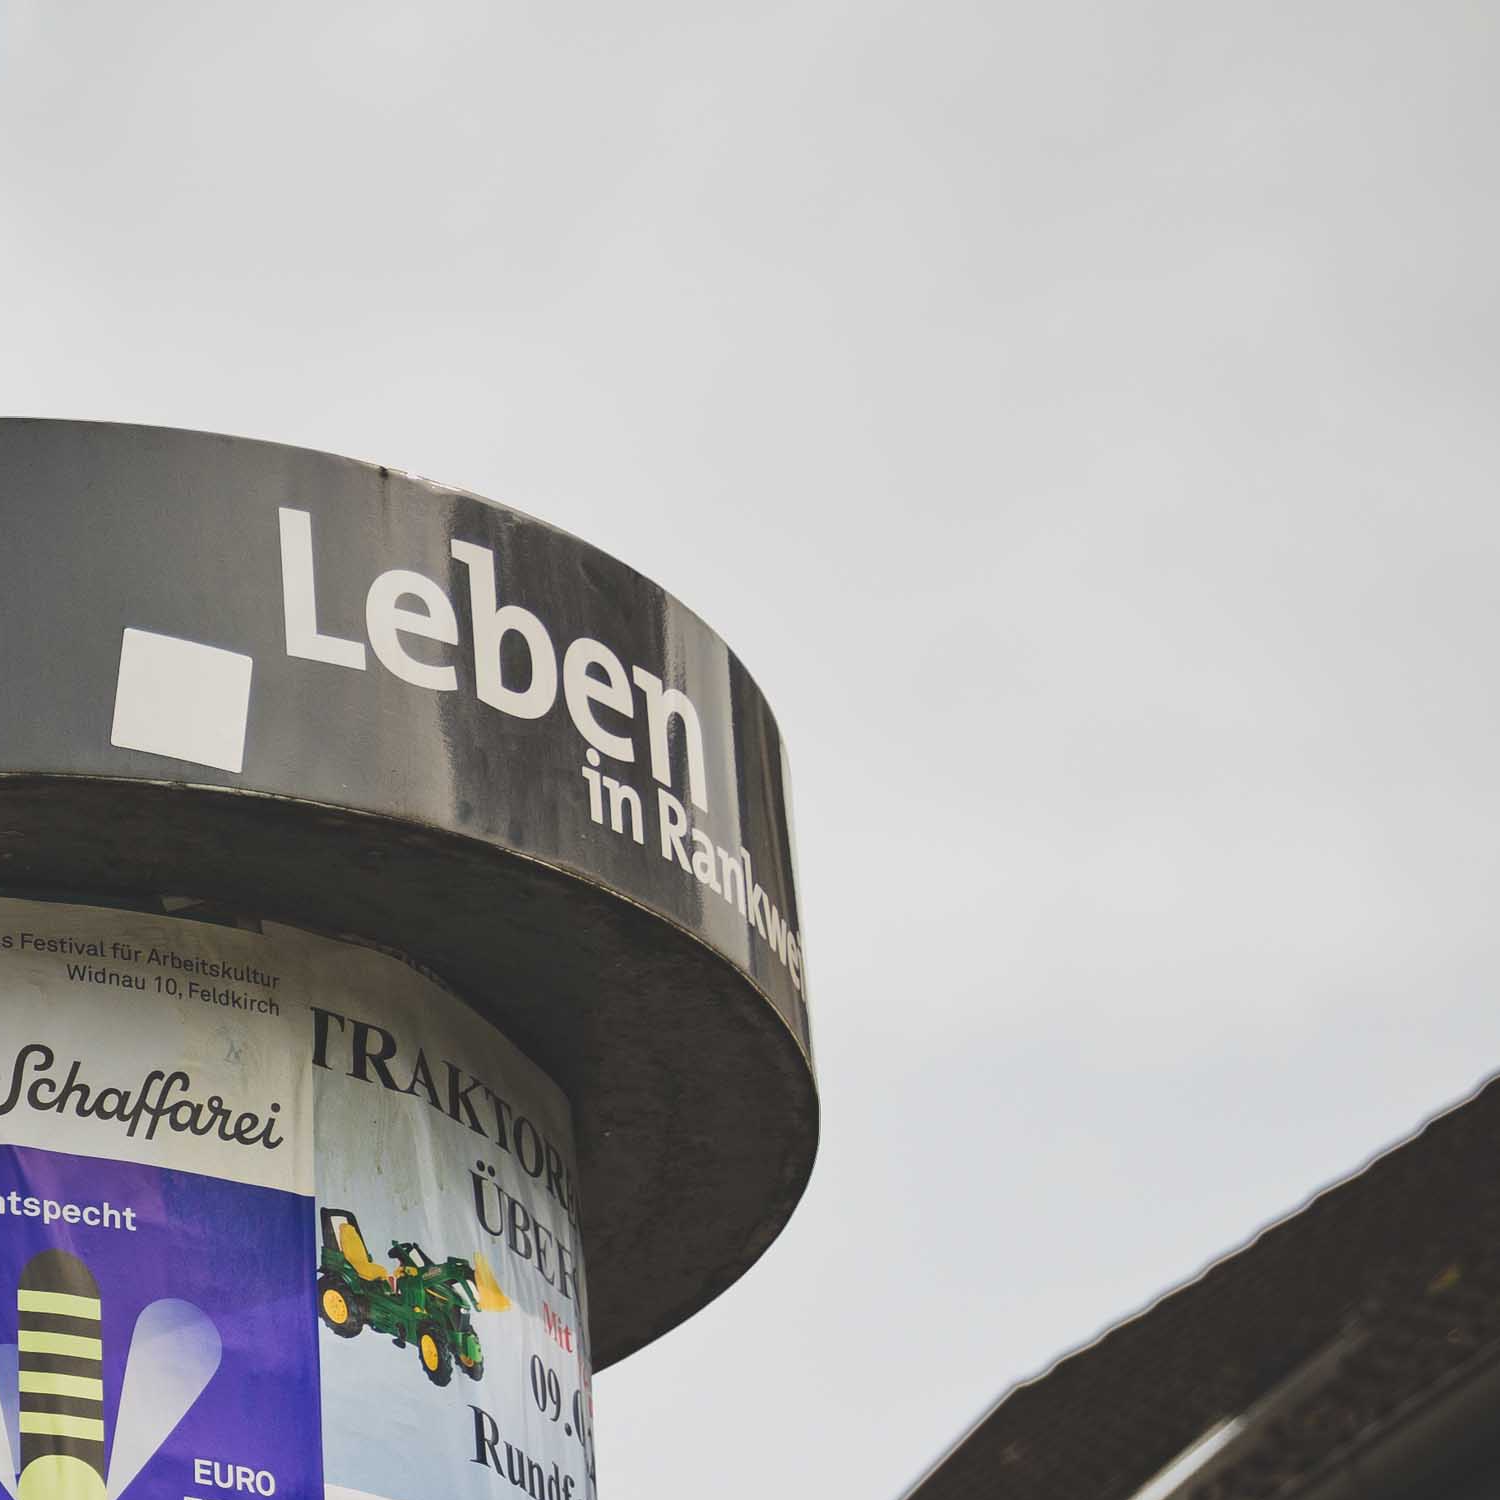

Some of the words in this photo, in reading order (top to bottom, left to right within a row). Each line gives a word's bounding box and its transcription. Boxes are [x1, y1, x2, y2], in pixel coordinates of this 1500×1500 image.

[278, 506, 708, 814] Leben
[582, 746, 645, 845] in
[20, 932, 106, 959] Festival
[112, 942, 143, 964] für
[146, 948, 281, 990] Arbeitskultur
[66, 963, 146, 991] Widnau
[153, 975, 183, 1000] 10,
[188, 982, 281, 1017] Feldkirch
[193, 1458, 277, 1497] EURO
